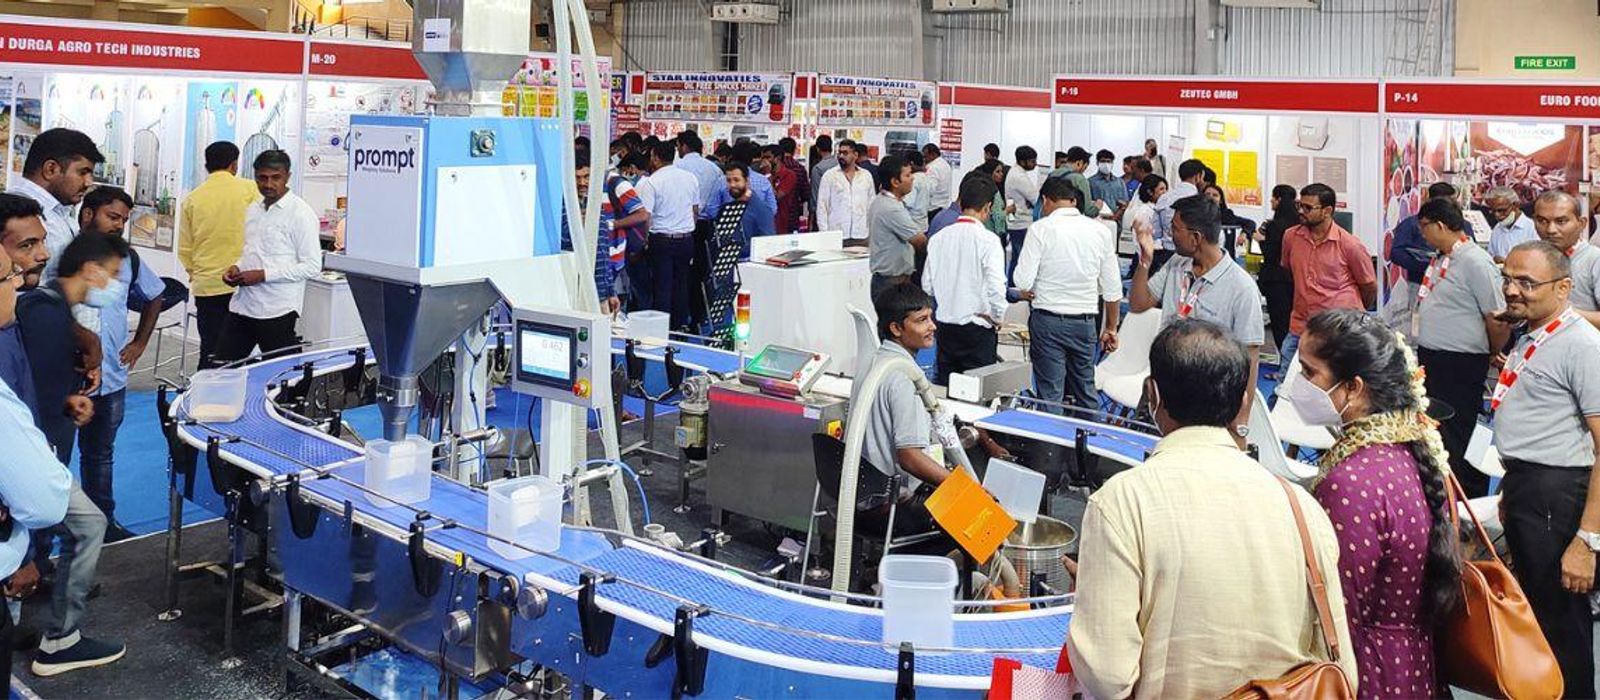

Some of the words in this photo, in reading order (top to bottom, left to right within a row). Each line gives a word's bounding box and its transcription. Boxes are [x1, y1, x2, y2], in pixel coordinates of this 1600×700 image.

[8, 38, 53, 51] DURGA
[57, 40, 92, 53] AGRO
[95, 42, 128, 55] TECH
[131, 44, 201, 59] INDUSTRIES
[311, 53, 336, 64] M-20
[1520, 58, 1544, 67] FIRE
[1545, 58, 1568, 67] EXIT
[825, 76, 853, 85] STAR
[1180, 89, 1212, 99] ZEUTEC
[1213, 89, 1238, 100] GMBH
[1394, 92, 1418, 103] P-14
[1540, 94, 1571, 106] EURO
[354, 147, 415, 174] prompt
